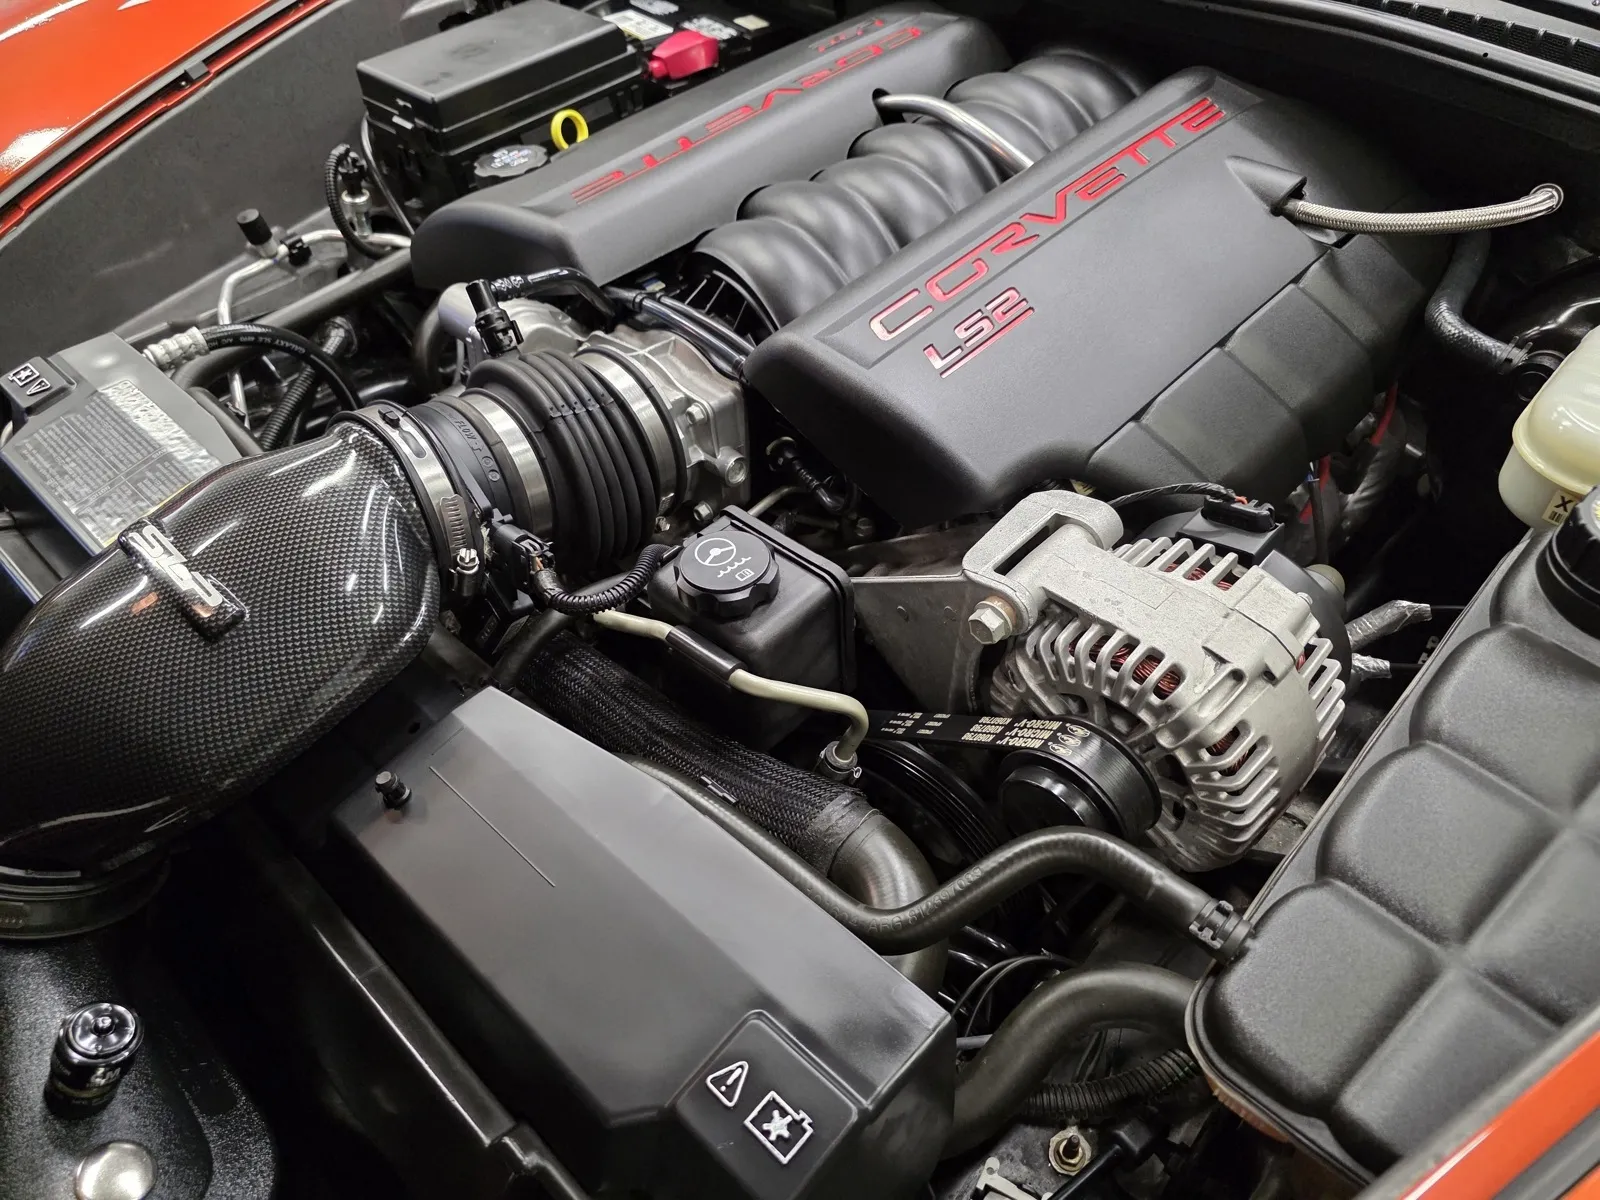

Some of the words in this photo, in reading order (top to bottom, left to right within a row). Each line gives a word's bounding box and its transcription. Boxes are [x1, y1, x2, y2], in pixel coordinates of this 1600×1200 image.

[570, 27, 922, 205] CORVETTE
[869, 96, 1226, 342] CORVETTE
[922, 286, 1033, 374] LS2
